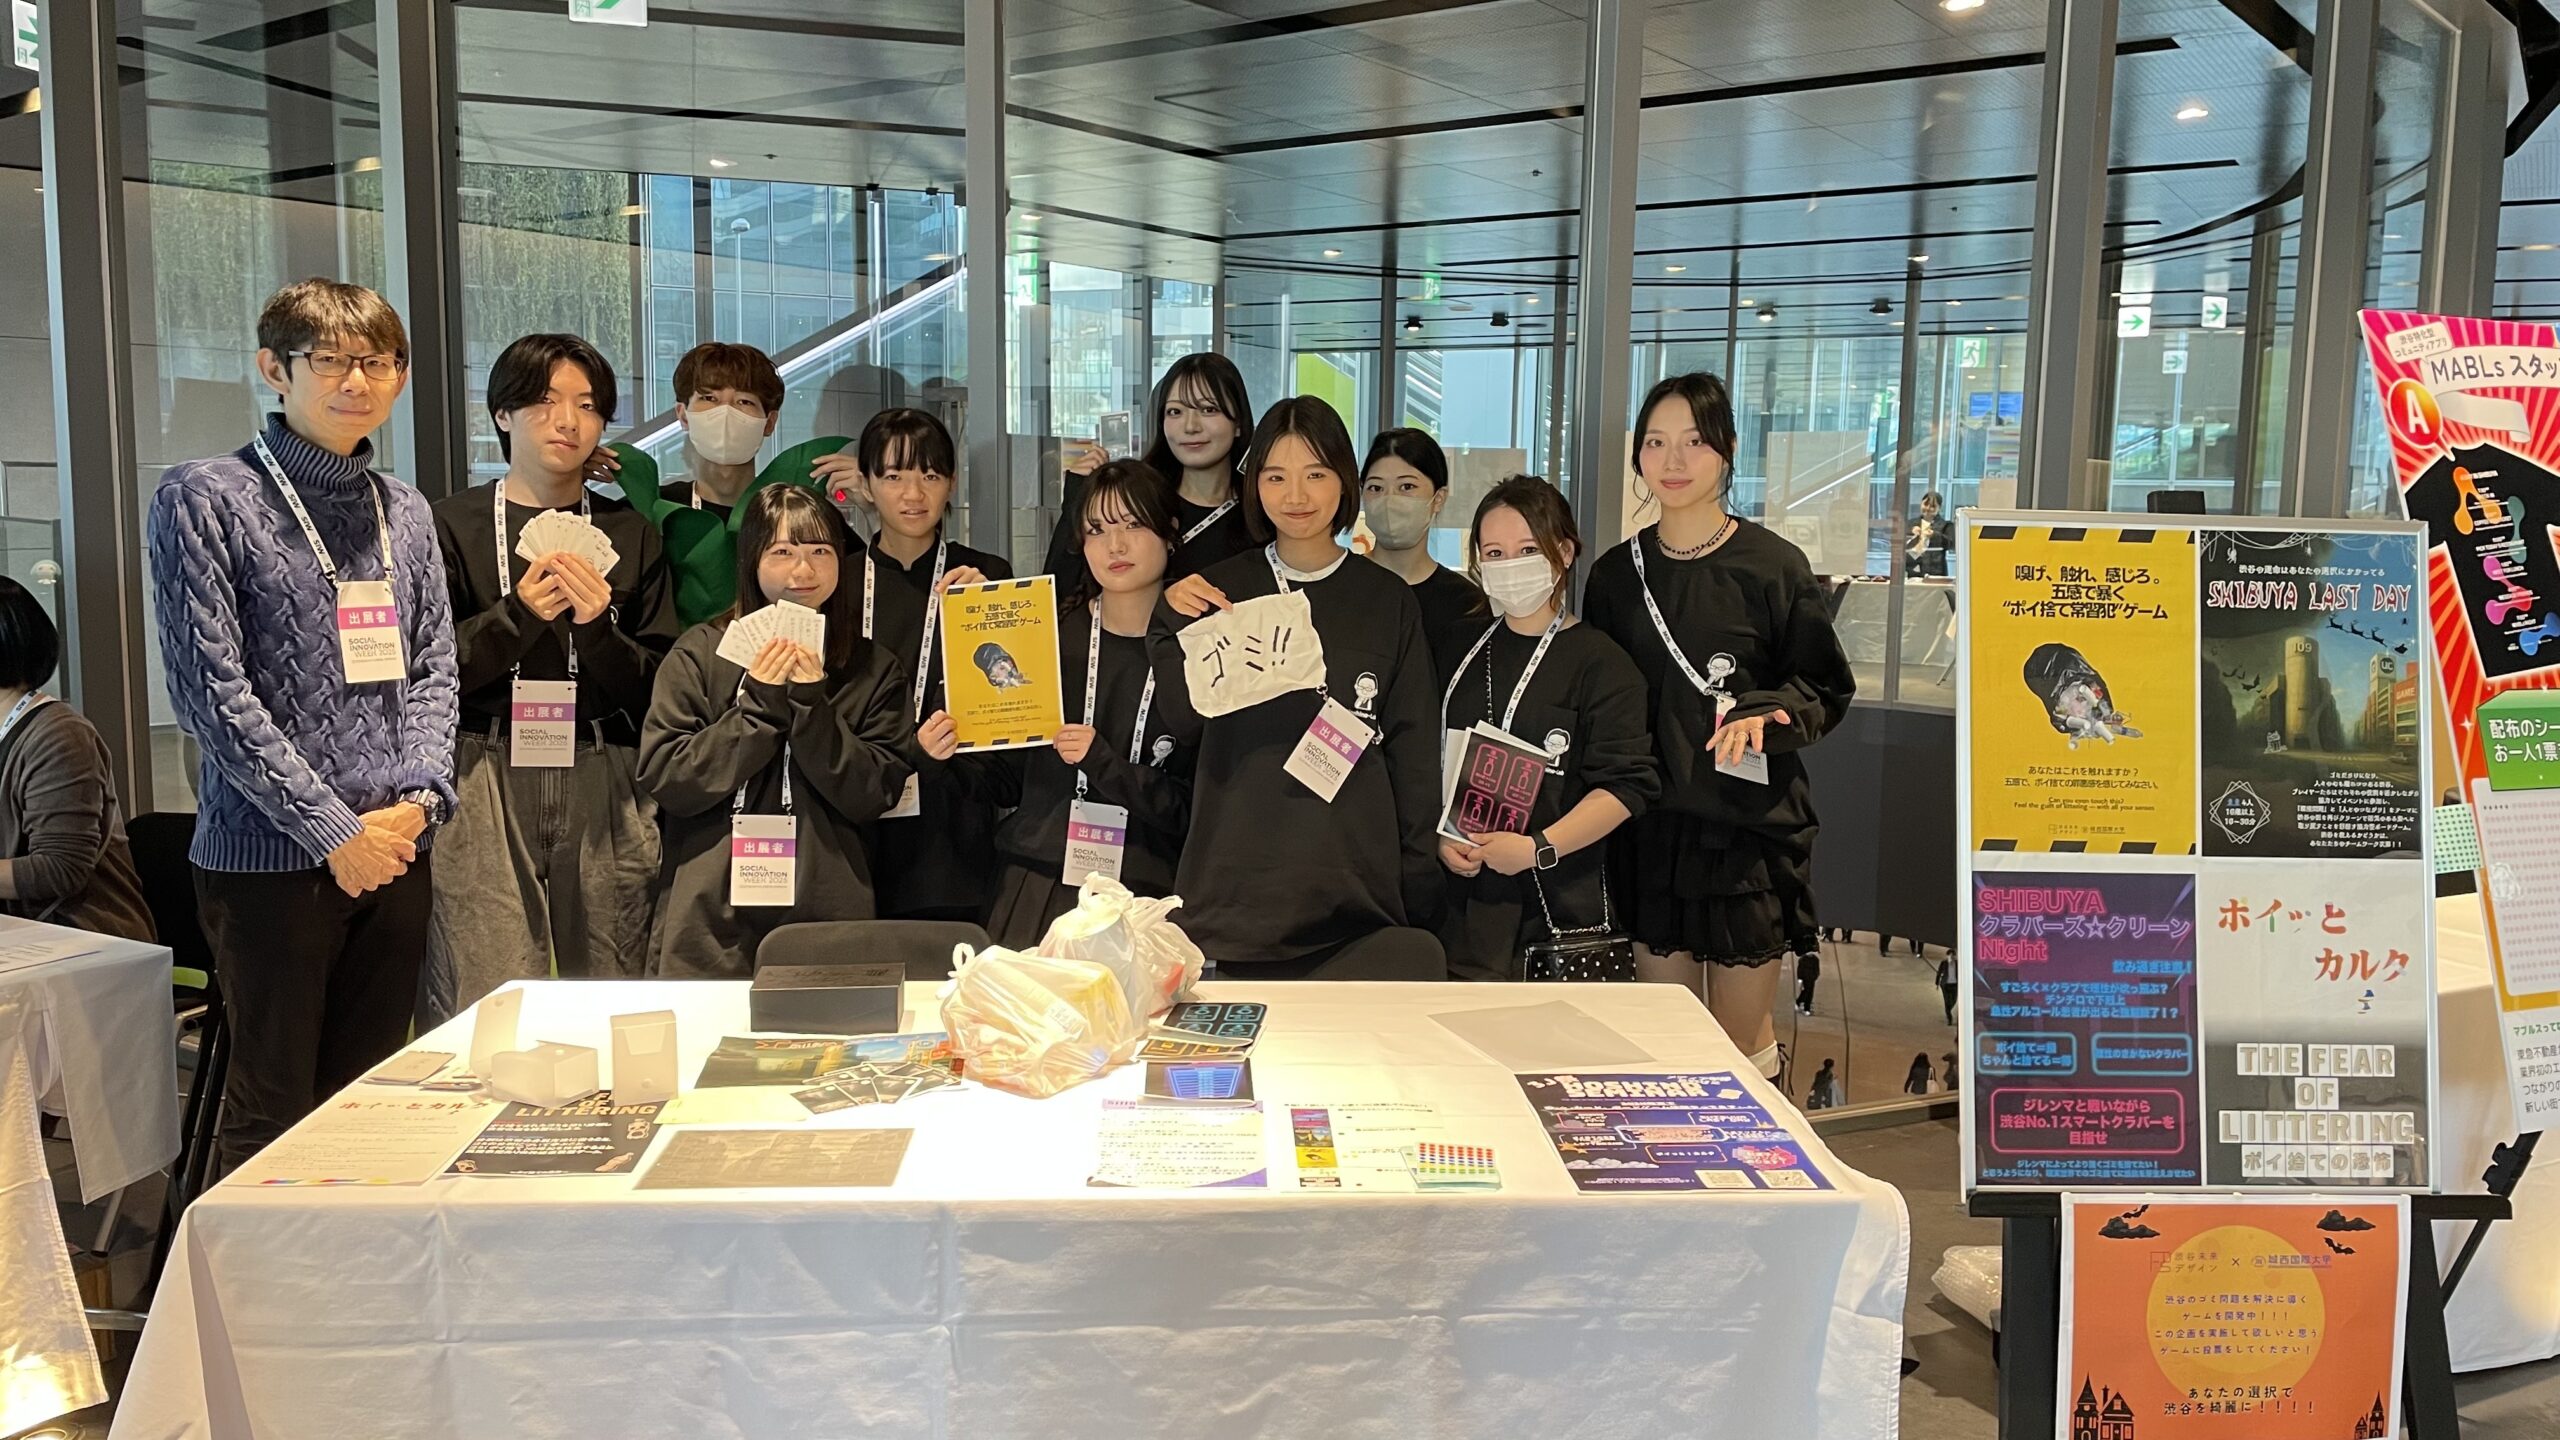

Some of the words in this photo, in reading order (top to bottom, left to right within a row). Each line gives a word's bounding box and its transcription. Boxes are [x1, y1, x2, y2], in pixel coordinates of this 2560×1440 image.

[2395, 338, 2447, 357] コミュニティアプリ
[2430, 354, 2505, 384] MABLs
[2509, 354, 2560, 379] スタッ
[2405, 388, 2430, 435] A
[275, 473, 288, 486] SIW
[288, 494, 300, 508] SIW
[301, 516, 313, 531] SIW
[314, 540, 325, 554] SIW
[2015, 565, 2160, 584] 嗅げ、触れ、感じろ。
[2051, 584, 2125, 601] 五感で暴く
[2207, 580, 2298, 610] SHIBUYA
[2308, 582, 2361, 611] LAST
[2372, 584, 2411, 612] DAY
[348, 610, 386, 624] 出展者
[348, 637, 376, 645] SOCIAL
[350, 642, 395, 652] INNOVATION
[524, 707, 563, 718] 出展者
[1320, 726, 1352, 754] 出展者
[1307, 742, 1328, 760] SOCIAL
[2494, 742, 2560, 762] お一人1票
[1304, 747, 1341, 776] INNOVATION
[744, 842, 784, 854] 出展者
[1073, 848, 1098, 856] SOCIAL
[1072, 854, 1114, 864] INNOVATION
[1979, 889, 2106, 914] SHIBUYA
[1979, 938, 2048, 963] Night
[2240, 1046, 2300, 1074] THE
[2311, 1047, 2393, 1075] FEAR
[2516, 1045, 2560, 1061] 東急不動産
[2297, 1081, 2335, 1107] OF
[516, 1106, 658, 1117] LITTERING
[2024, 1099, 2150, 1113] ジレンマと戦いながら
[2525, 1098, 2560, 1113] 新しい街
[2221, 1114, 2414, 1142] LITTERING
[2069, 1131, 2108, 1145] 目指せ
[2244, 1148, 2393, 1175] ポイ捨ての恐怖
[2174, 1264, 2218, 1273] デザイン
[2188, 1386, 2292, 1400] あなたの選択で
